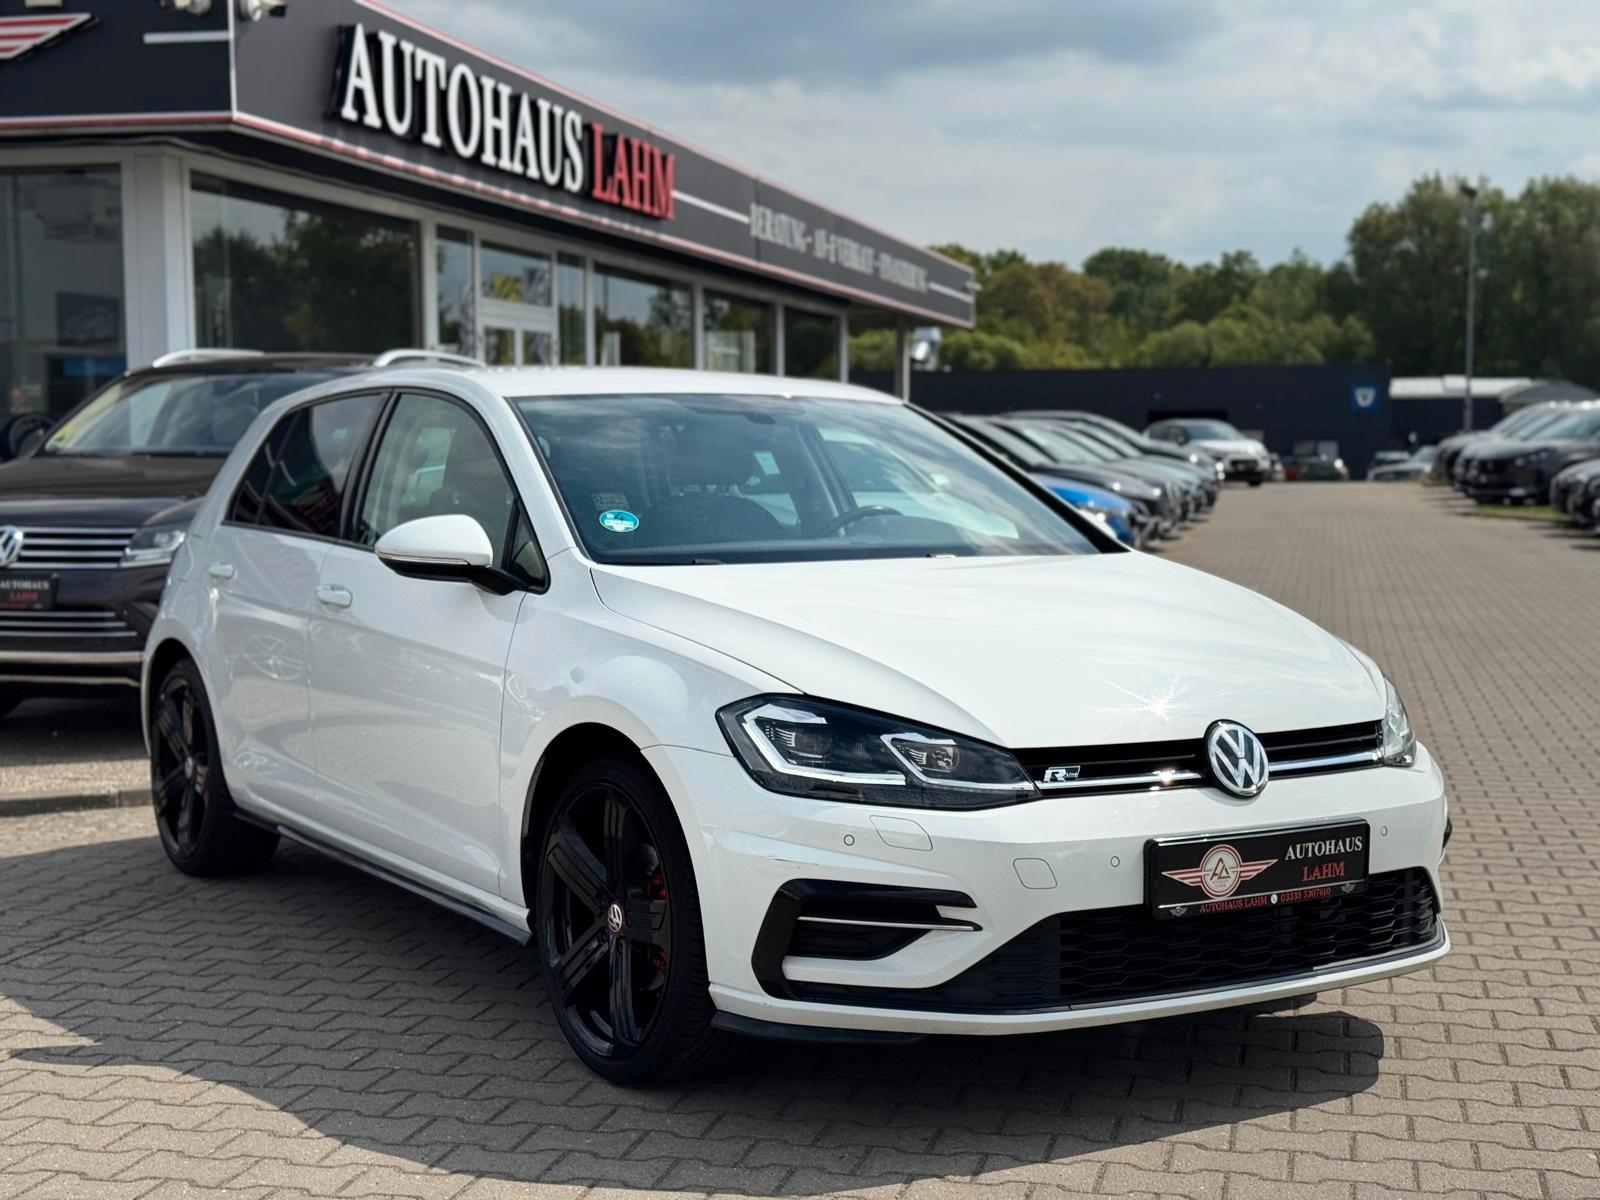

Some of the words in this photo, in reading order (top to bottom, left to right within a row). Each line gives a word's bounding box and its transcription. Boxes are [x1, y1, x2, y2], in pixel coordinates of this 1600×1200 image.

[341, 22, 585, 193] AUTOHAUS
[592, 121, 676, 221] LAHM
[1208, 722, 1268, 796] VW
[1285, 836, 1363, 861] AUTOHAUS
[1302, 861, 1345, 882] LAHM
[1200, 899, 1243, 913] AUTOHAUS
[1245, 896, 1268, 907] LAHM
